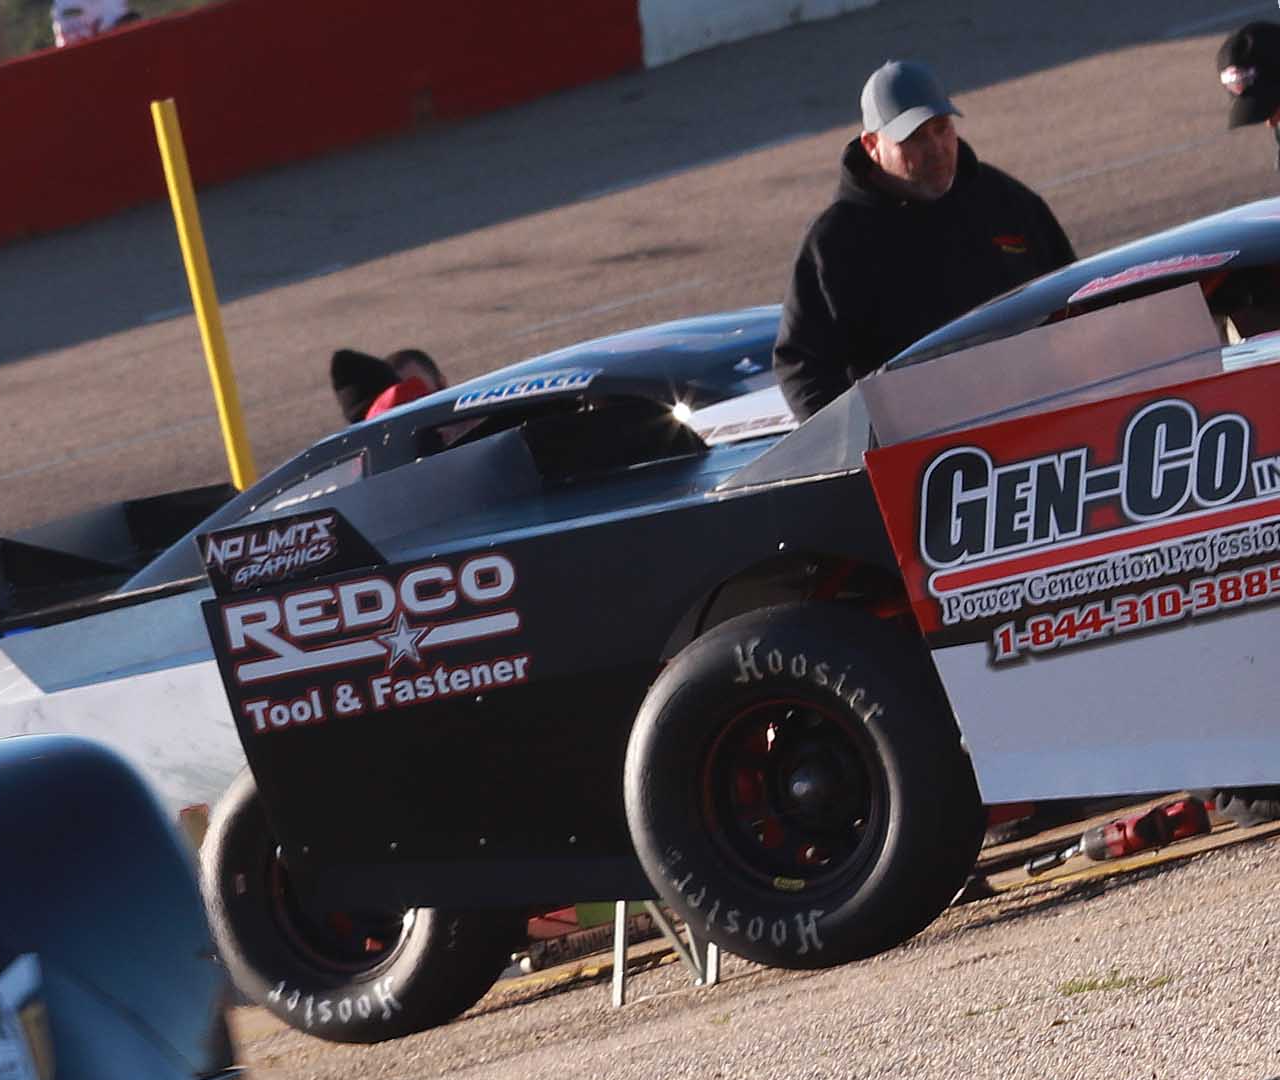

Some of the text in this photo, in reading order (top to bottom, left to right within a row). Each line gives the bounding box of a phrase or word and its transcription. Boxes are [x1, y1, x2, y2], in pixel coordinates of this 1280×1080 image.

[206, 515, 334, 566] NO LIMITS
[234, 543, 333, 584] GRAPHICS
[944, 524, 1280, 624] Power Generation Professio
[225, 554, 516, 655] REDCO
[247, 654, 530, 730] Tool & Fastener
[733, 636, 886, 724] Hoosier
